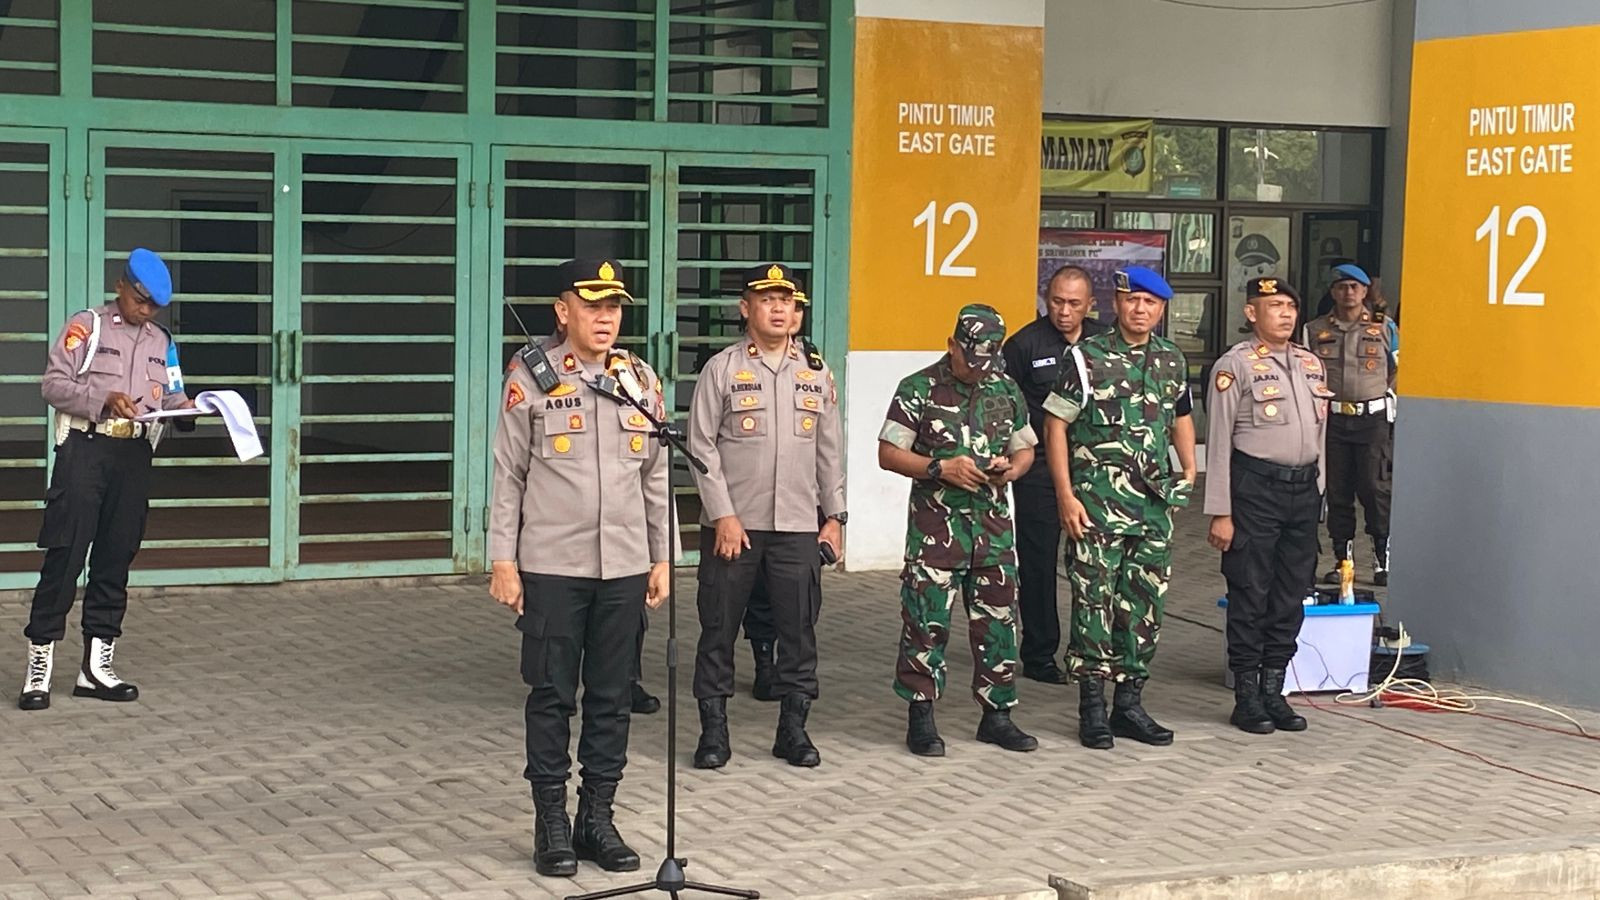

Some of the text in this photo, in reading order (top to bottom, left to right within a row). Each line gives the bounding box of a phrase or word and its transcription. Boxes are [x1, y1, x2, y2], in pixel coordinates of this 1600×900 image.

[898, 102, 995, 127] PINTU TIMUR
[1469, 102, 1575, 136] PINTU TIMUR
[898, 131, 996, 156] EAST GATE
[1466, 143, 1573, 176] EAST GATE
[913, 200, 979, 277] 12
[1475, 205, 1548, 307] 12
[795, 383, 822, 394] POLRI
[545, 397, 582, 410] AGUS
